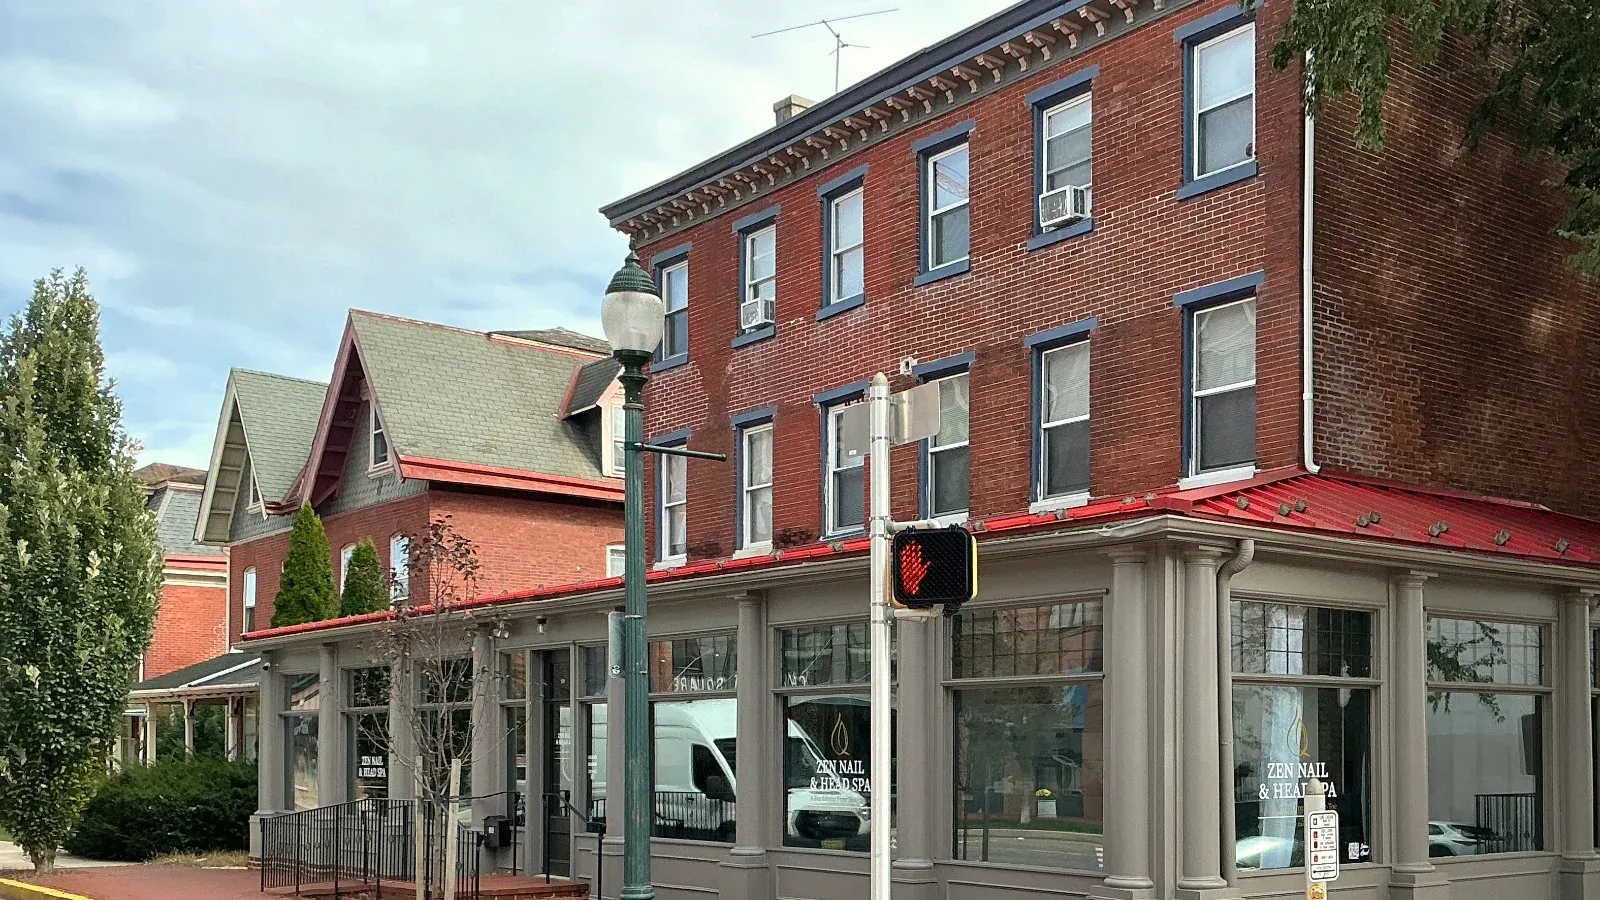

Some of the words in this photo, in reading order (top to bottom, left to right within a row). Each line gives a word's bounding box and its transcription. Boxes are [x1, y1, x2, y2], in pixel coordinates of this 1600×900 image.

[816, 760, 837, 774] ZEN
[839, 760, 865, 774] NAIL
[1267, 762, 1293, 779] ZEN
[1298, 762, 1329, 778] NAIL
[810, 776, 818, 790] &
[820, 777, 850, 791] HEAD
[852, 777, 871, 792] SPA
[1258, 783, 1270, 799] &
[1323, 781, 1338, 798] PA
